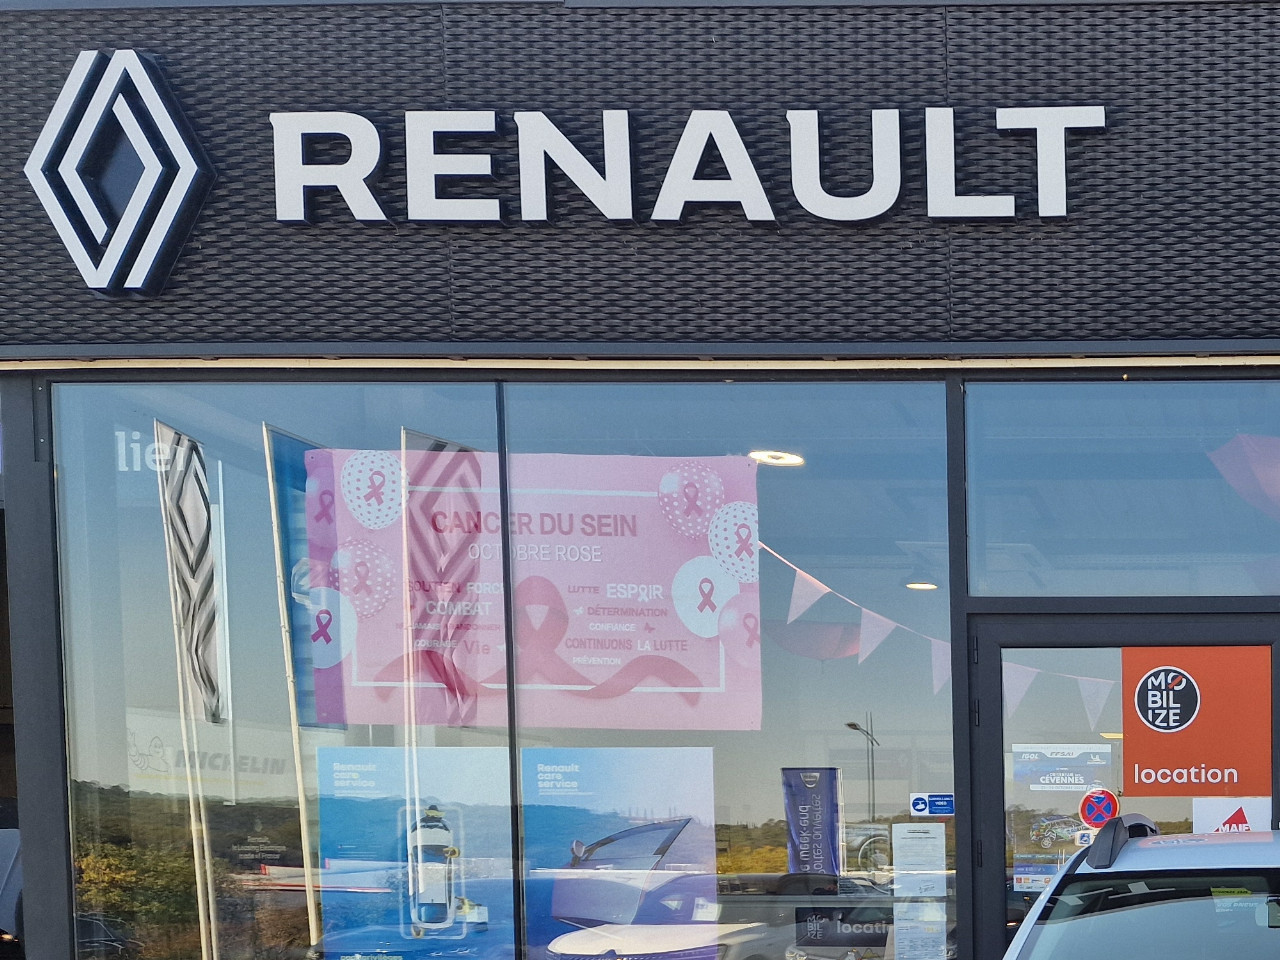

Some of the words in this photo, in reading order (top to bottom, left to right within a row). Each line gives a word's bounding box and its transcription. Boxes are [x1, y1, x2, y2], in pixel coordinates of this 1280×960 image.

[269, 105, 1107, 222] RENAULT
[539, 513, 574, 535] DU
[580, 514, 638, 537] SEIN
[555, 545, 603, 562] ROSE
[567, 585, 600, 594] LUTTE
[425, 600, 492, 616] COMBAT
[587, 604, 668, 617] DÉTERMINATION
[589, 622, 637, 632] CONFIANCE
[463, 640, 491, 655] Vie
[565, 637, 633, 650] CONTINUONS
[637, 639, 651, 651] LA
[653, 639, 688, 651] LUTTE
[1147, 690, 1181, 708] BIL
[1147, 709, 1181, 727] IZE
[537, 763, 580, 773] Renault
[1134, 763, 1238, 784] location
[537, 780, 578, 788] service
[1218, 823, 1250, 832] MAIF
[836, 920, 889, 934] locati
